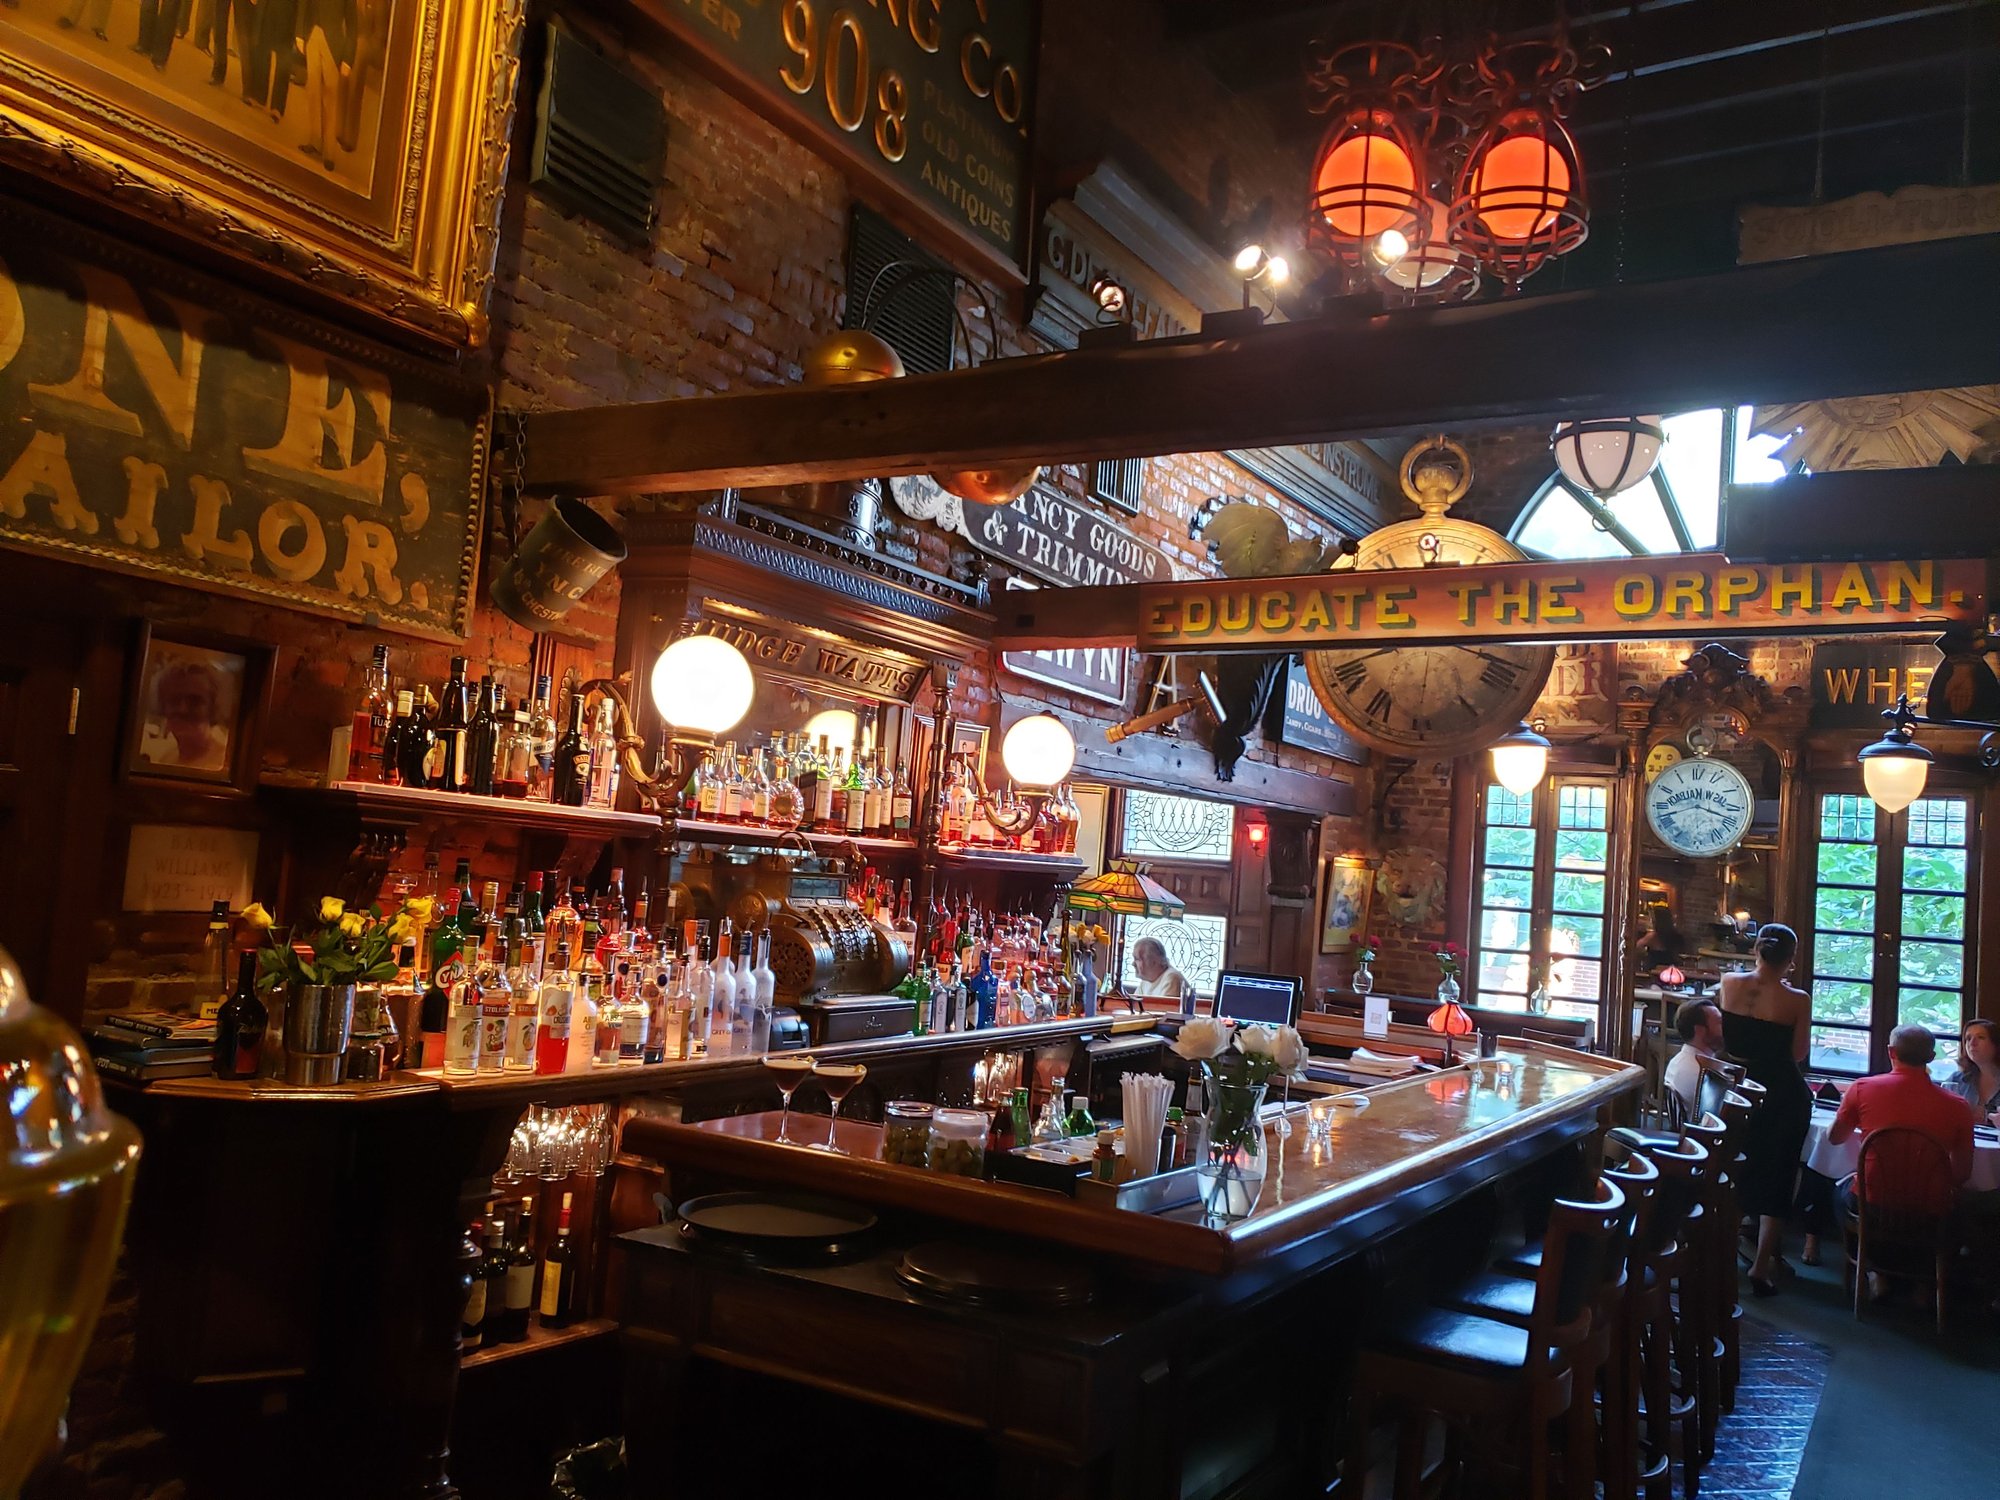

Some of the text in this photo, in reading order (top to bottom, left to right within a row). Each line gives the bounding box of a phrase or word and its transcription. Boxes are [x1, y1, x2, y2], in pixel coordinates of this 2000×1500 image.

[779, 0, 908, 163] 908
[924, 80, 1015, 166] PLATINUM
[921, 160, 1012, 242] ANTIQUES
[922, 119, 1015, 208] OLD COINS
[982, 510, 1008, 546] &
[1090, 523, 1157, 579] GOODS
[1149, 560, 1966, 635] EDUCATE THE ORPHAN.
[816, 647, 917, 694] WATTS
